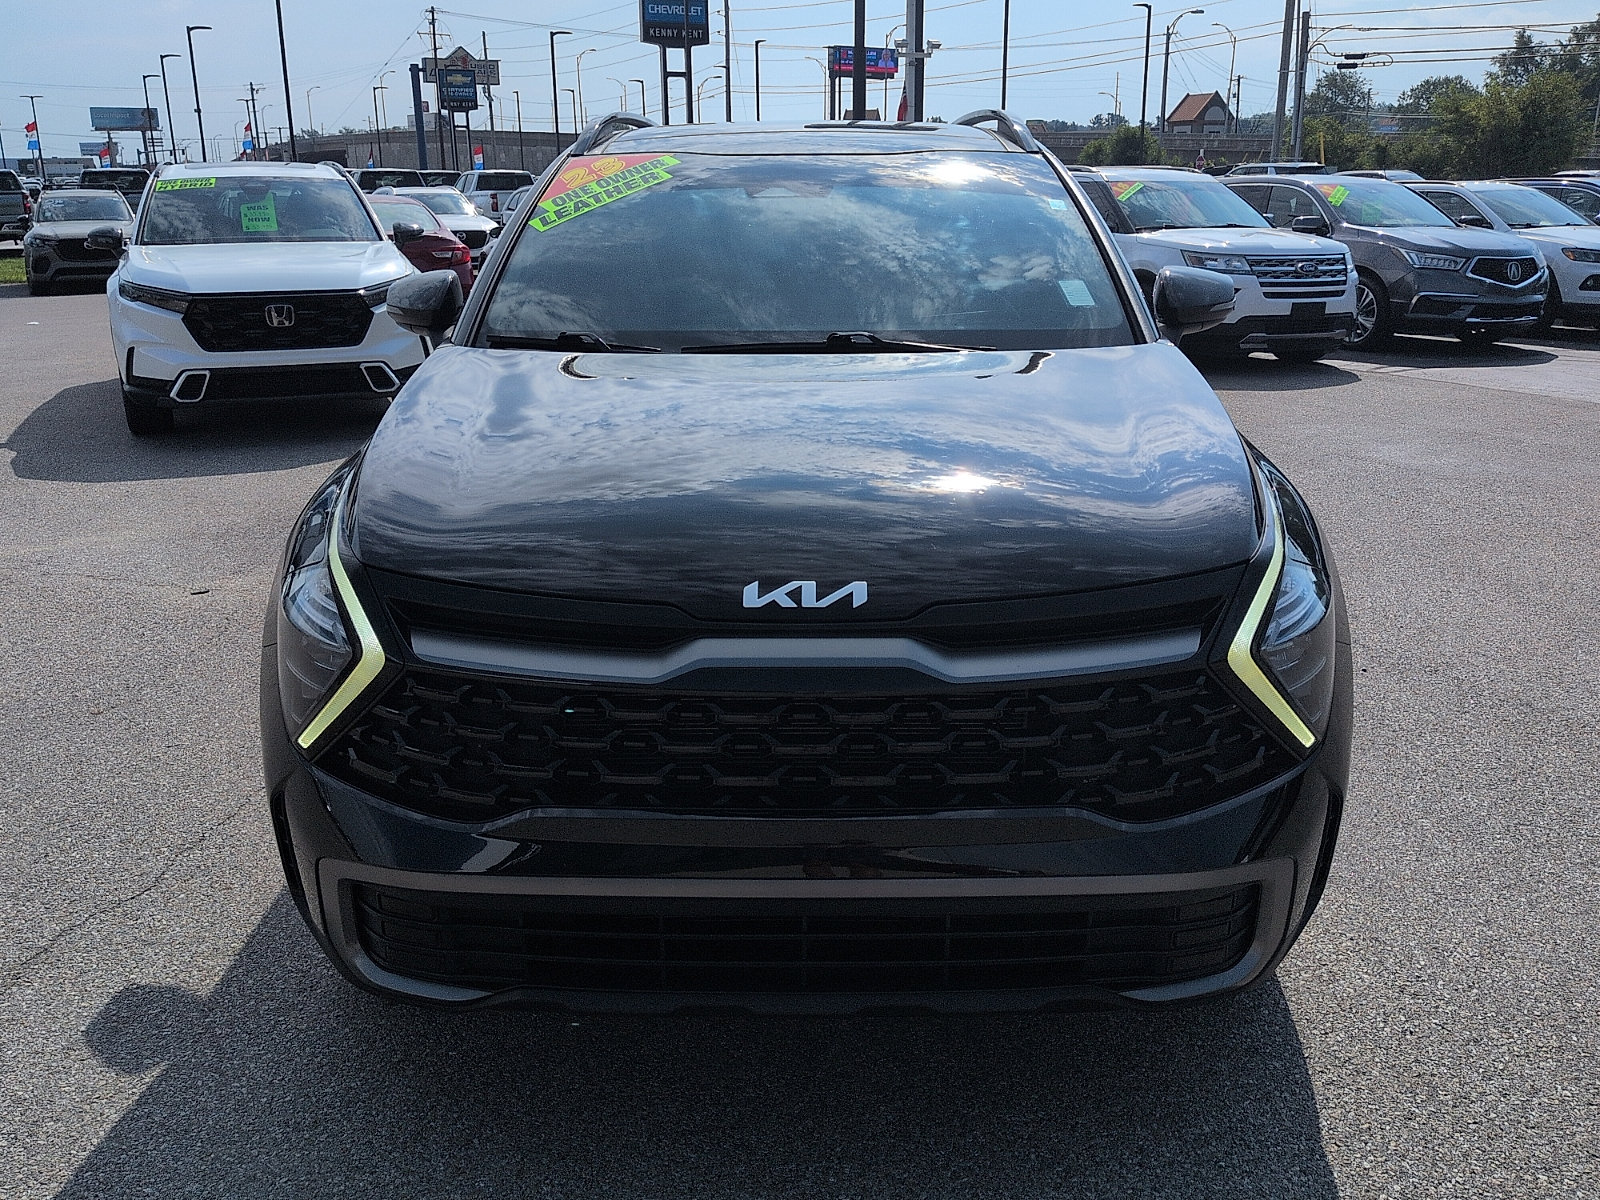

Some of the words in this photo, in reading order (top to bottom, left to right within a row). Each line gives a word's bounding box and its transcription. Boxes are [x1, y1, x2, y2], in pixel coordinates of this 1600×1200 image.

[649, 27, 678, 37] KENNY
[682, 29, 703, 39] KENT
[158, 182, 214, 191] HYBRID
[551, 183, 596, 208] ONE
[595, 158, 667, 189] OWNER
[560, 157, 626, 189] 23
[538, 171, 661, 228] LEATHER
[742, 580, 868, 609] KIA
